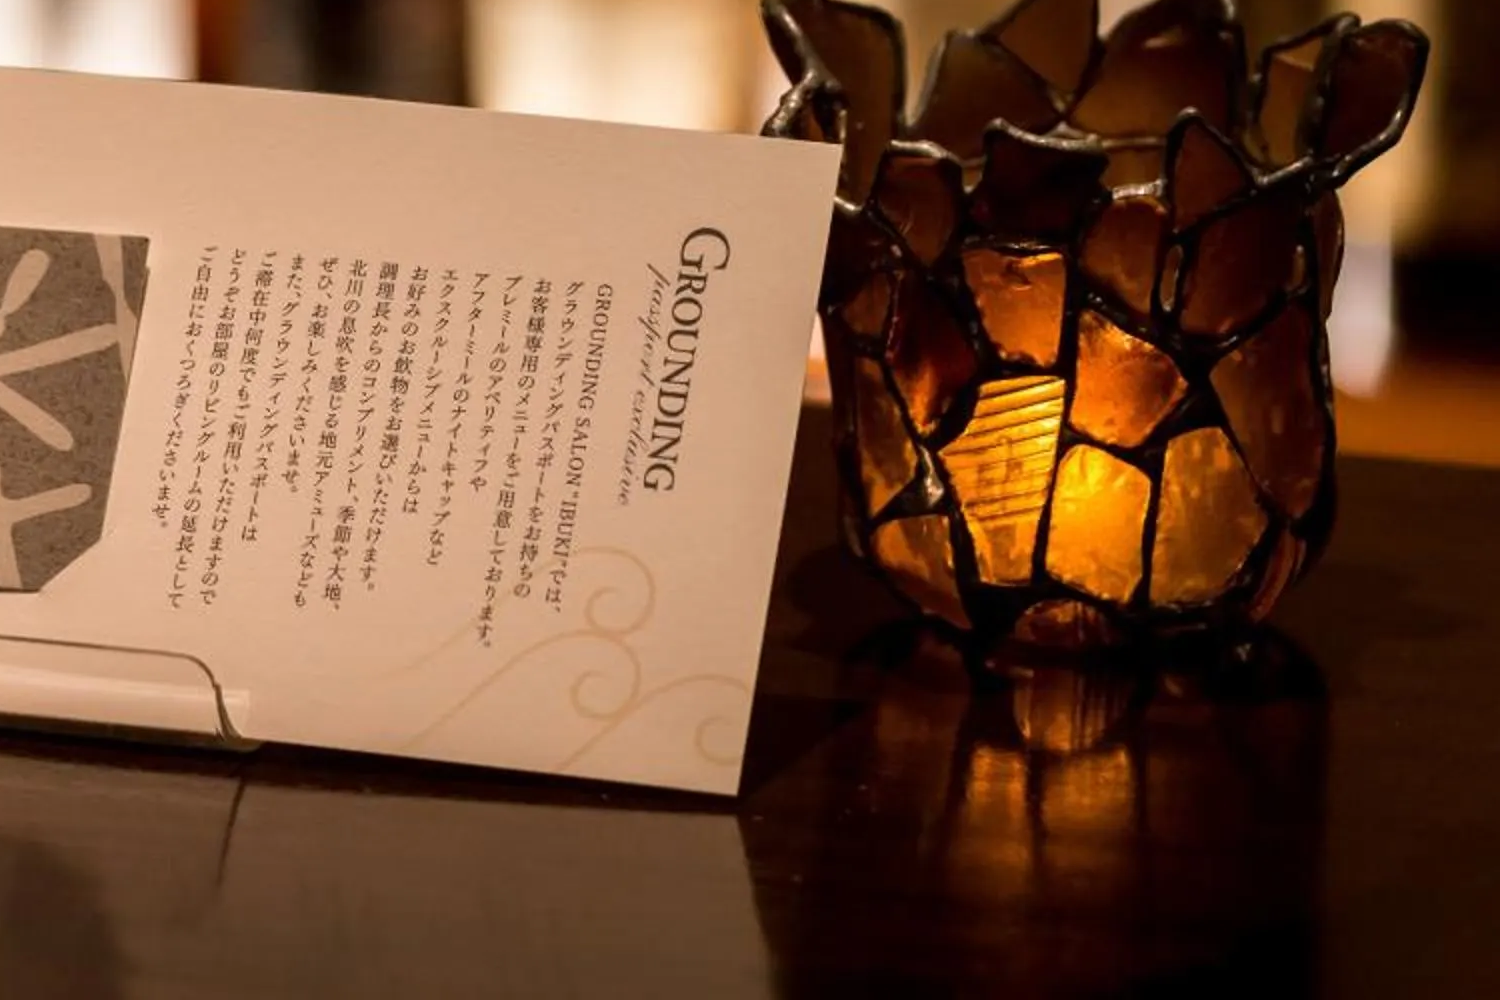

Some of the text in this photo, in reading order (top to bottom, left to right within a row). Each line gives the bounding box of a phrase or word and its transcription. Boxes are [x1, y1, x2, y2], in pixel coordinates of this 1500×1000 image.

[152, 246, 218, 527] ご自由におくつろぎくださいませ。
[281, 257, 339, 492] ぜひ、お楽しみくださいませ。
[514, 281, 584, 598] グラウンディングパスポートをお持ちの
[578, 283, 614, 411] GROUNDING
[638, 263, 671, 387] passport
[643, 227, 730, 492] GROUNDING
[566, 416, 591, 487] SALON
